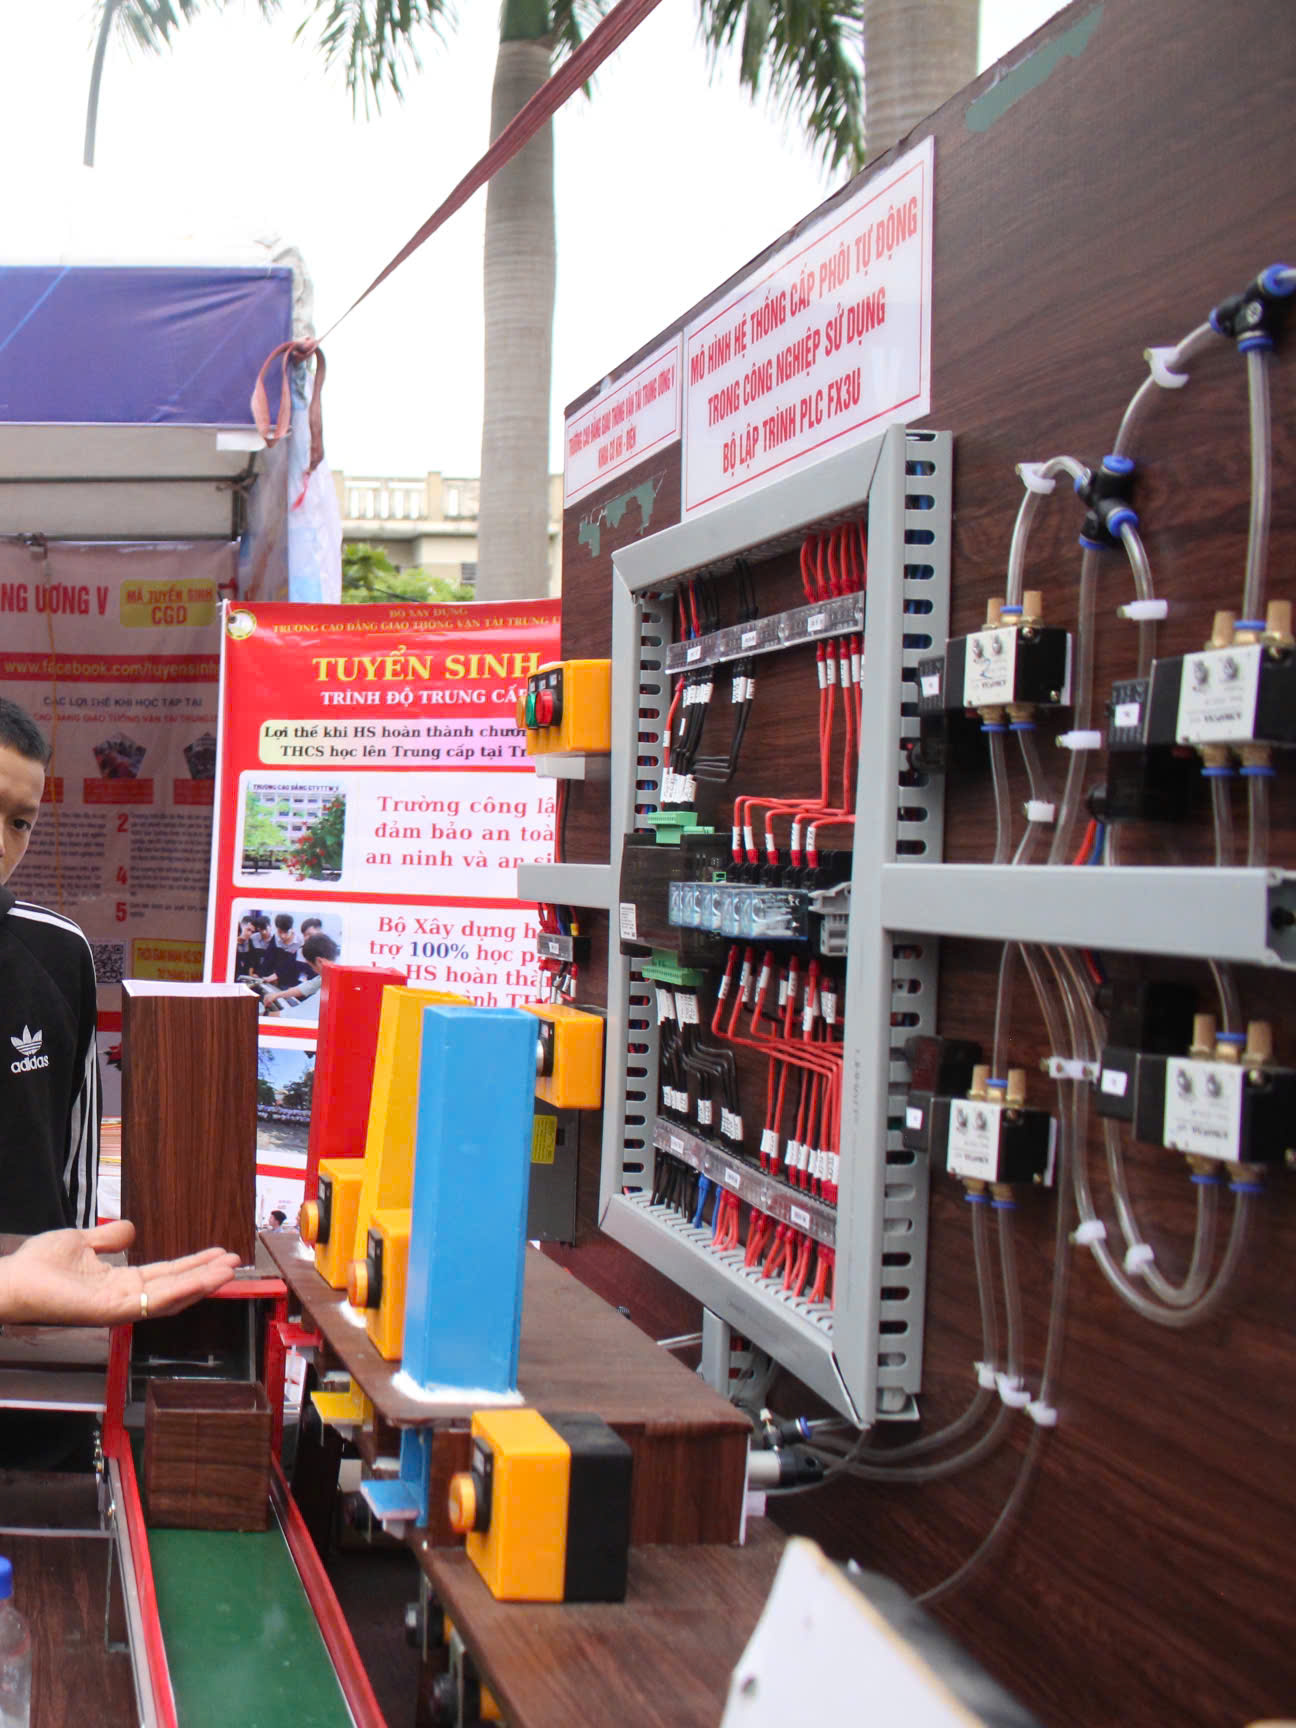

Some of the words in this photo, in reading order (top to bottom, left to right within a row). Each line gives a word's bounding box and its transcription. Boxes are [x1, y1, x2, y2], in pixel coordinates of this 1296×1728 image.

[691, 344, 704, 386] MÔ
[708, 331, 731, 374] HÌNH
[734, 313, 747, 358] HỆ
[750, 288, 786, 344] THỐNG
[790, 262, 815, 317] CẤP
[819, 242, 850, 298] PHÔI
[855, 224, 873, 276] TỰ
[876, 196, 918, 260] ĐỘNG
[708, 380, 740, 427] TRONG
[743, 359, 772, 406] CÔNG
[776, 326, 820, 386] NGHIỆP
[825, 302, 845, 357] SỬ
[847, 286, 886, 346] DỤNG
[723, 432, 736, 477] BỘ
[739, 422, 759, 469] LẬP
[763, 403, 796, 452] TRÌNH
[800, 389, 823, 434] PLC
[827, 367, 861, 419] FX3U
[35, 581, 89, 616] ƯƠNG
[97, 585, 109, 616] V
[151, 605, 188, 625] CGD
[312, 645, 433, 681] TUYỂN
[445, 652, 542, 680] SINH
[320, 687, 381, 705] TRÌNH
[387, 686, 414, 708] ĐỘ
[418, 689, 486, 705] TRUNG
[264, 726, 289, 740] Lợi
[294, 725, 319, 738] thế
[323, 726, 348, 738] khi
[353, 726, 376, 738] HS
[382, 725, 421, 738] hoàn
[426, 725, 473, 738] thành
[280, 745, 325, 757] THCS
[330, 745, 358, 760] học
[363, 744, 386, 757] lên
[392, 745, 441, 760] Trung
[446, 743, 475, 760] cấp
[480, 745, 502, 760] tại
[508, 745, 527, 757] Tr
[377, 795, 460, 817] Trường
[469, 796, 527, 818] công
[537, 796, 555, 818] lậ
[117, 813, 129, 833] 2
[375, 820, 422, 839] đảm
[431, 821, 473, 840] bảo
[482, 827, 510, 841] an
[520, 824, 554, 842] toà
[366, 851, 392, 865] an
[401, 850, 453, 866] ninh
[463, 850, 488, 868] và
[116, 866, 127, 885] 4
[115, 902, 127, 922] 5
[378, 916, 406, 936] Bộ
[414, 917, 455, 939] Xây
[461, 920, 516, 942] dựng
[524, 922, 538, 939] h
[369, 940, 403, 959] trợ
[410, 941, 469, 960] 100%
[476, 944, 513, 965] học
[406, 963, 437, 981] HS
[446, 965, 498, 985] hoàn
[11, 1055, 49, 1073] adidas
